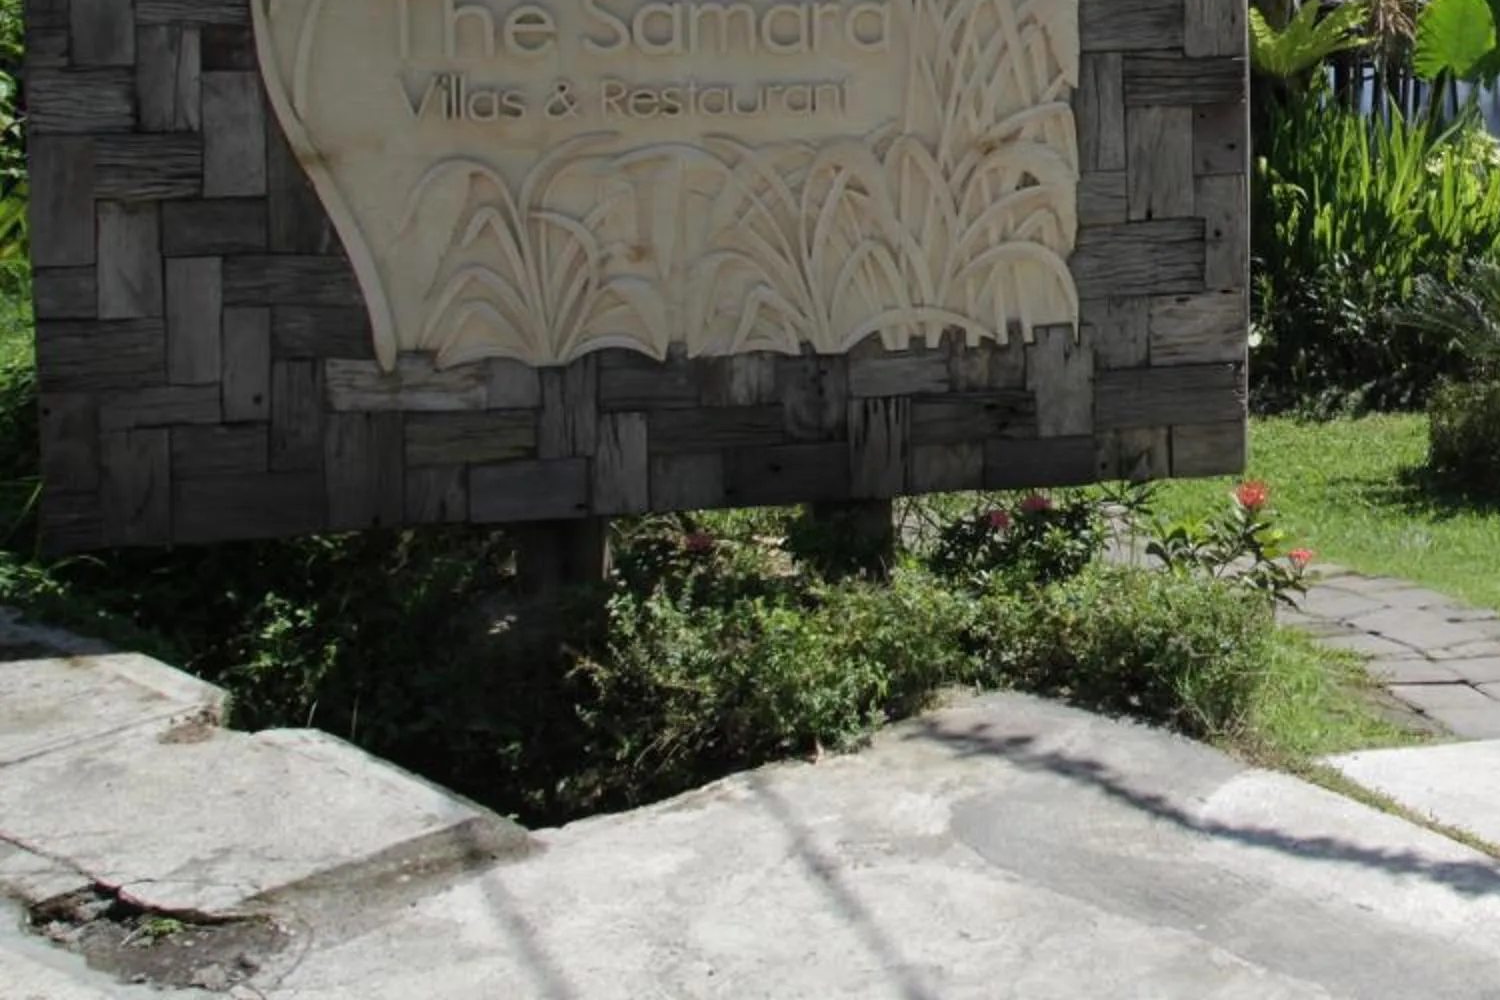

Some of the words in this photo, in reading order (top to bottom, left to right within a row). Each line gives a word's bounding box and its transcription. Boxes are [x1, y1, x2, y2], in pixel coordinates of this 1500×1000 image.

[399, 72, 527, 121] Villas
[545, 84, 582, 121] &
[602, 76, 849, 120] Restaurant
